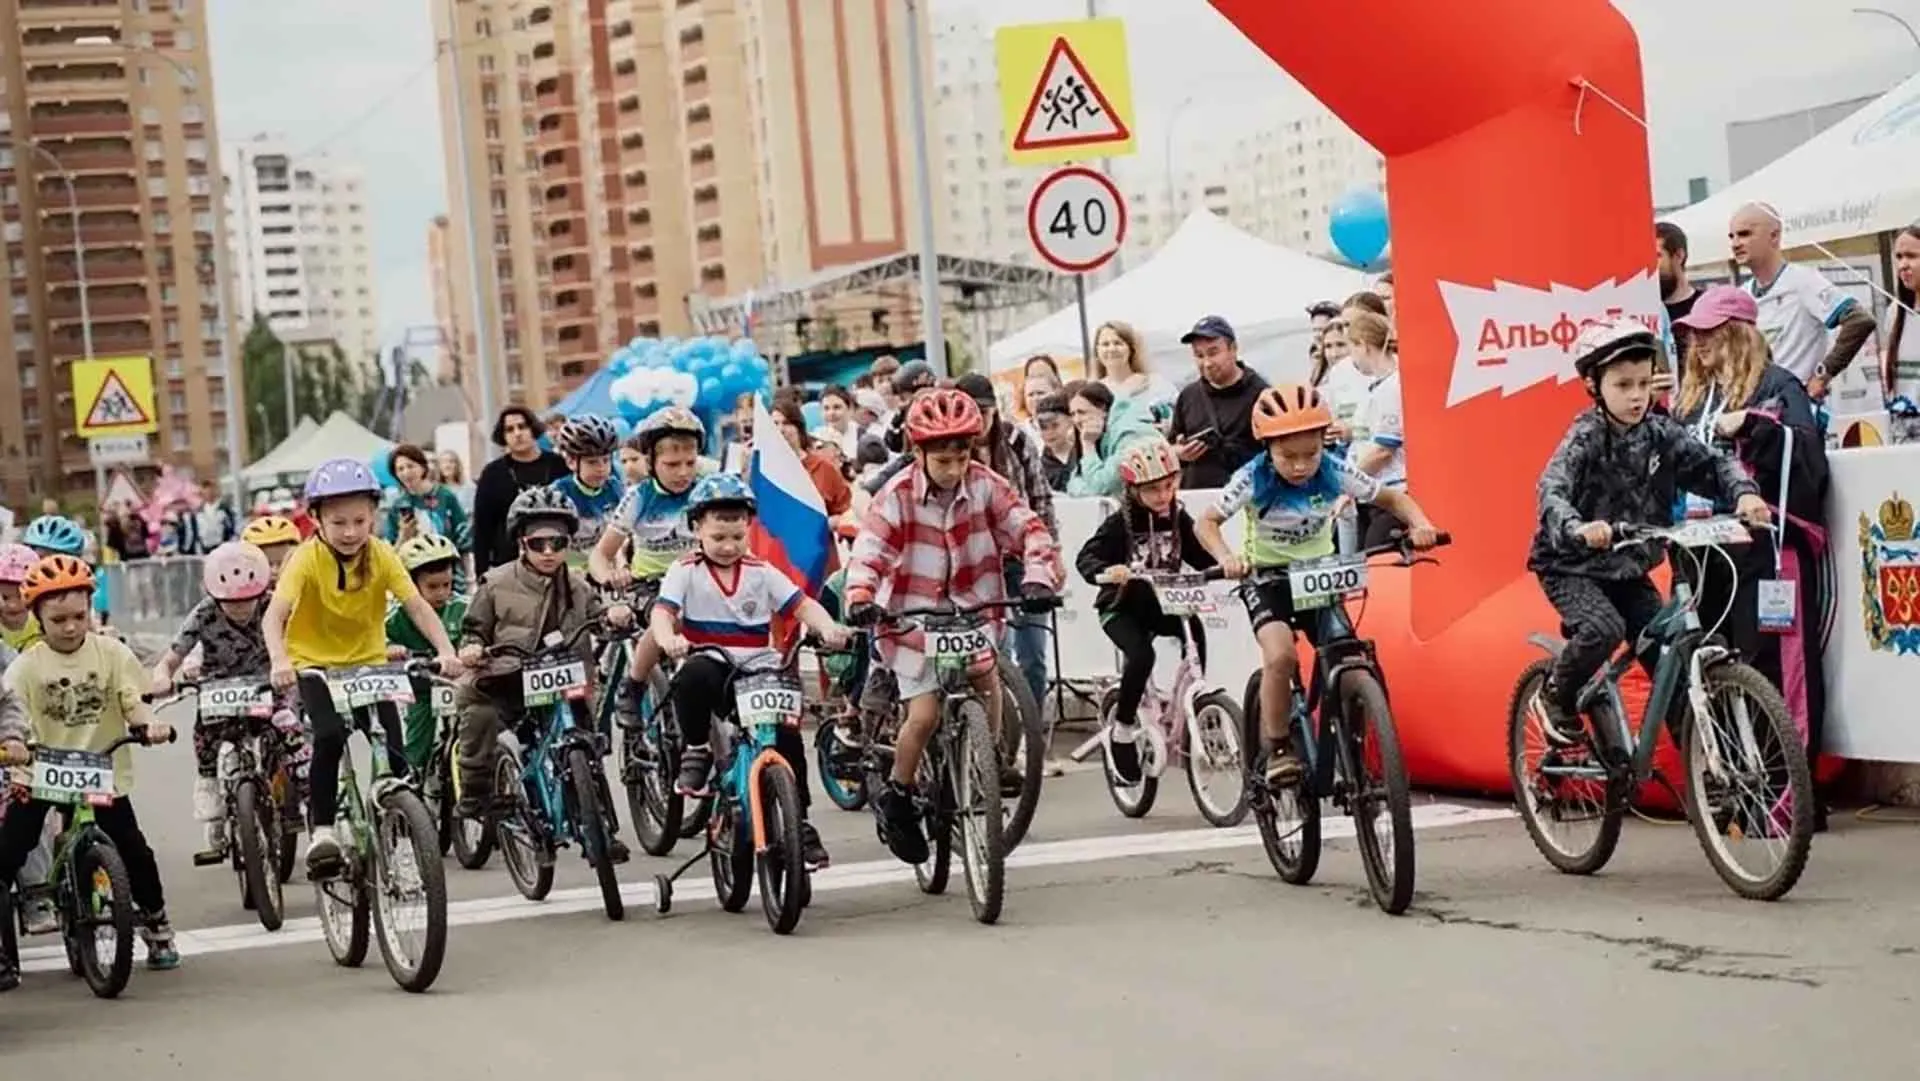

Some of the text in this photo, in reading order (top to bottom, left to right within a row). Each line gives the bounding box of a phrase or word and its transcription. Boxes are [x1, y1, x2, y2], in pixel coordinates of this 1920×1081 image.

[1049, 198, 1107, 239] 40
[1477, 311, 1600, 354] Альф
[1303, 568, 1358, 593] 0020
[936, 631, 986, 654] 0036
[343, 678, 400, 694] 0023
[530, 667, 573, 691] 0061
[750, 691, 794, 711] 0022
[45, 767, 101, 789] 0034
